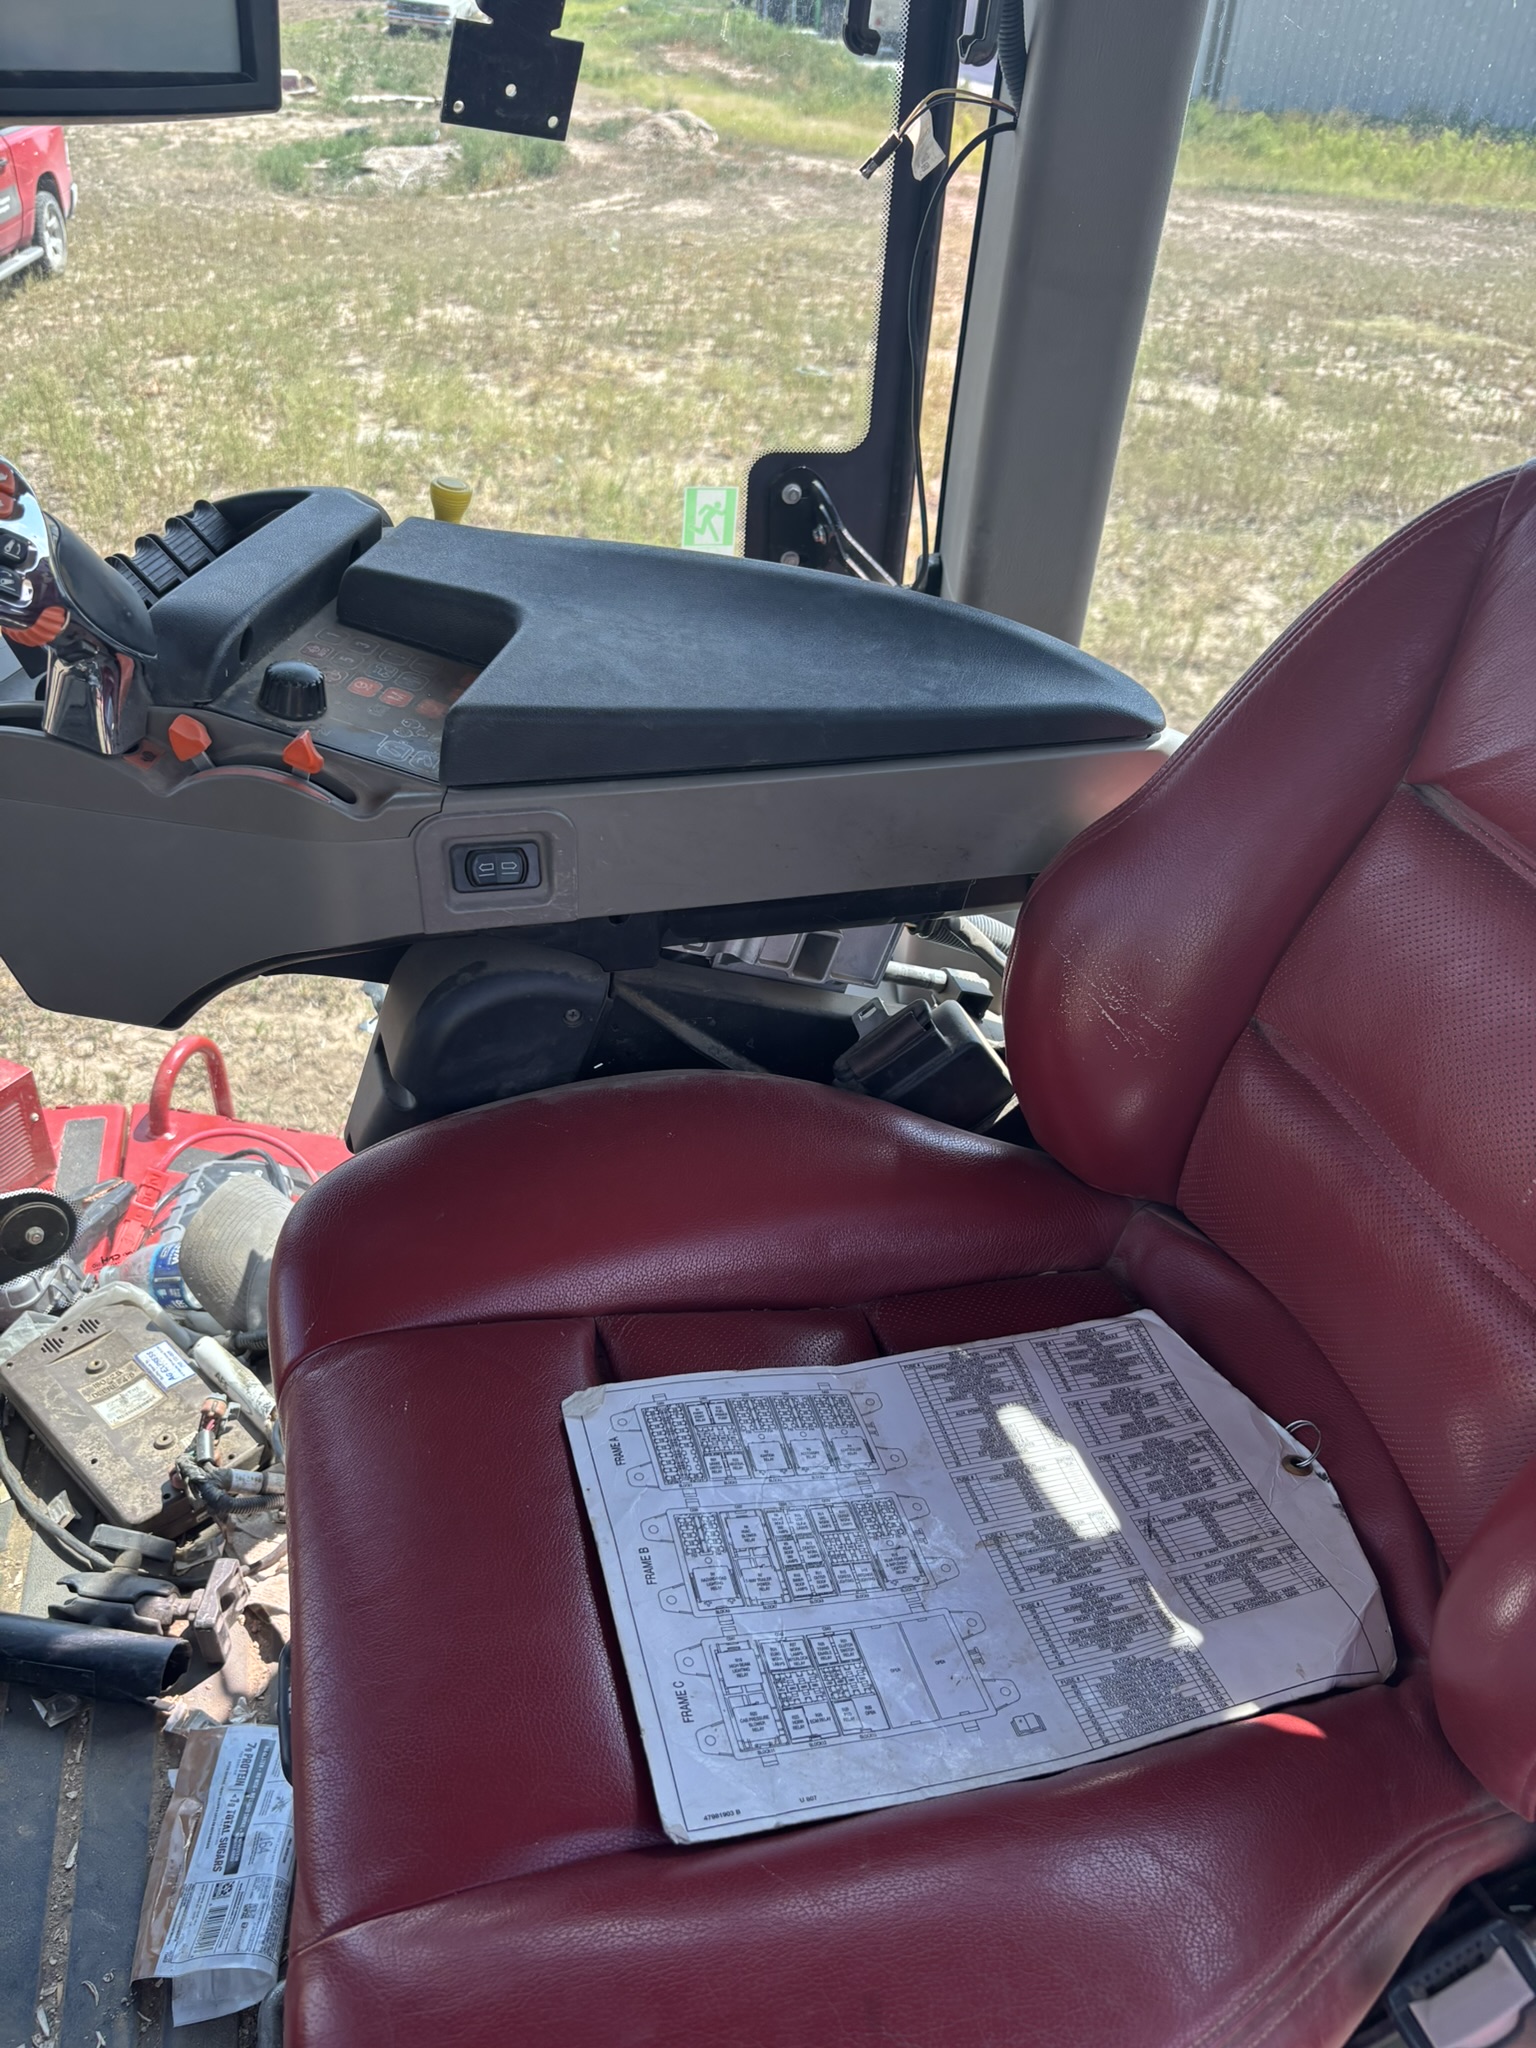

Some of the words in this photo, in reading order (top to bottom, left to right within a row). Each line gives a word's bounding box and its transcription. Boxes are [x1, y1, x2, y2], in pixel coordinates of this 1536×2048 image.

[610, 1442, 626, 1466] FRAME
[639, 1555, 658, 1585] FRAME
[672, 1680, 684, 1688] C
[675, 1689, 694, 1723] FRAME
[243, 1742, 257, 1752] 7g
[233, 1753, 253, 1786] PROTEIN
[220, 1809, 236, 1835] TOTAL
[211, 1836, 230, 1872] SUGARS
[257, 1835, 274, 1856] 164
